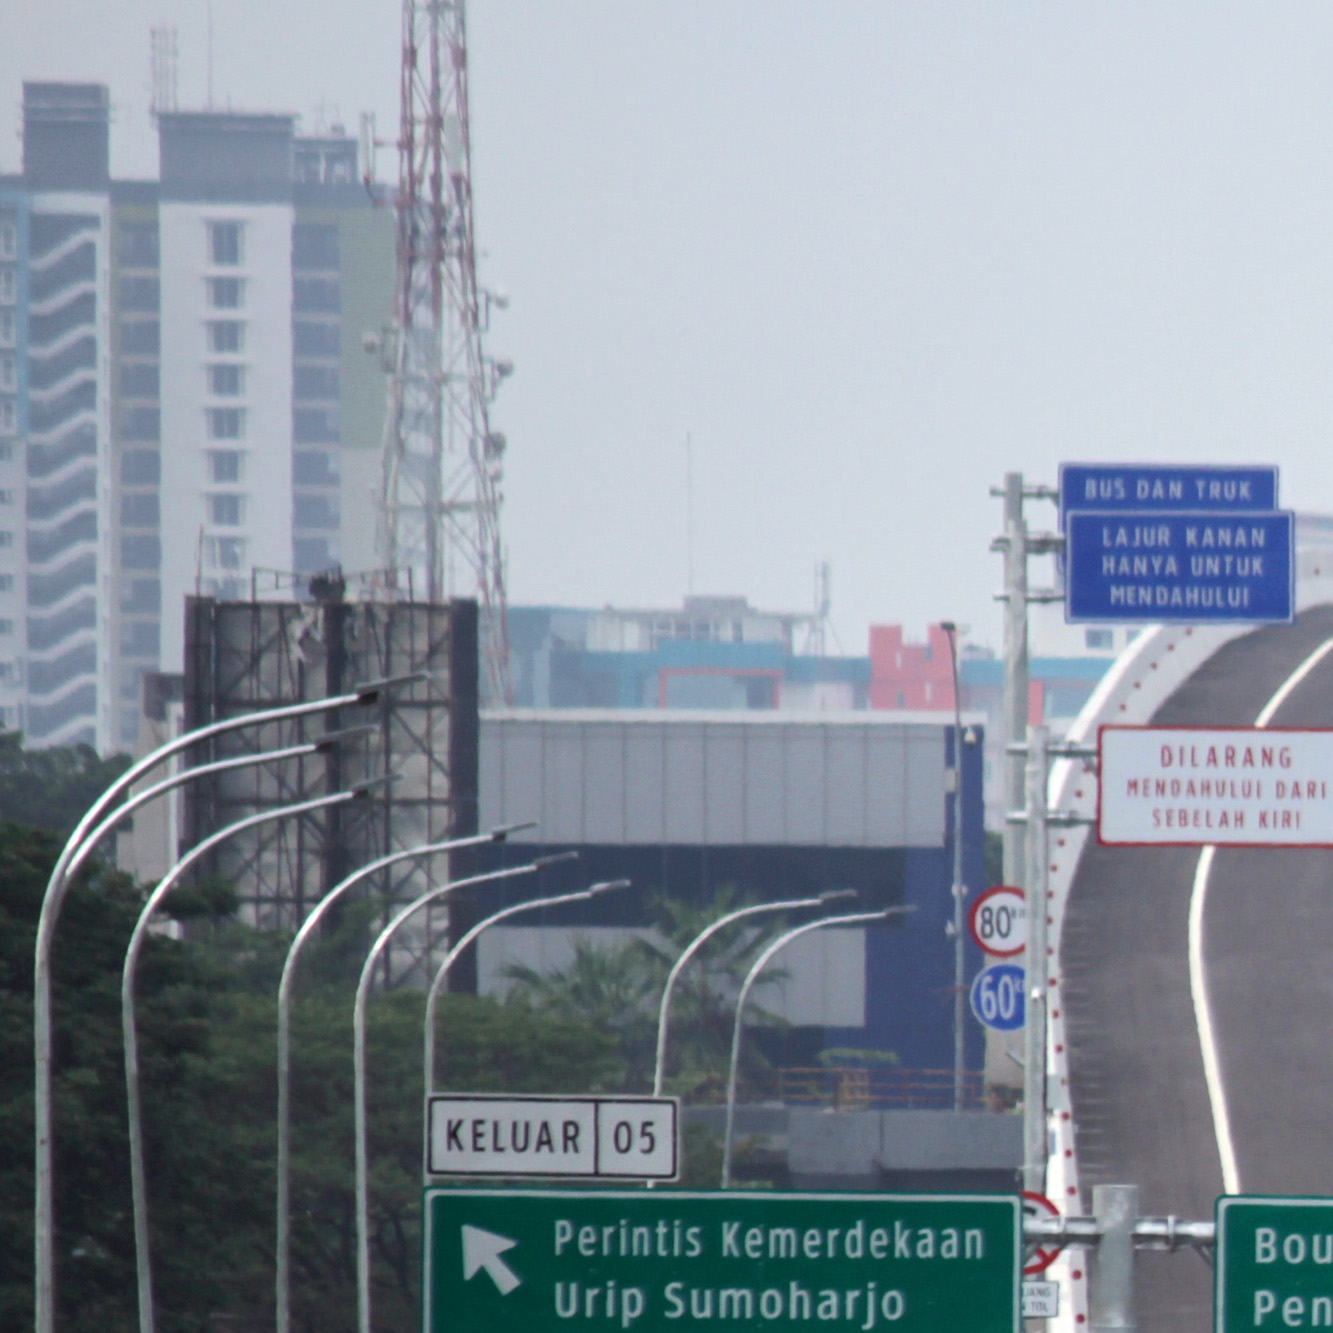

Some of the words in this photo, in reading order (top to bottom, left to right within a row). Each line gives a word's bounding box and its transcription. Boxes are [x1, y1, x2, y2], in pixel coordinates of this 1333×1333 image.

[1084, 478, 1125, 500] BUS
[1137, 479, 1182, 499] DAN
[1196, 480, 1252, 500] TRUK
[1103, 526, 1171, 547] LAJUR
[1186, 527, 1265, 547] KANAN
[1102, 555, 1178, 576] HANYA
[1191, 556, 1264, 576] UNTUK
[1110, 585, 1249, 608] MENDAHULUI
[1161, 745, 1292, 769] DILARANG
[1126, 778, 1262, 800] MENDAHULUI
[1276, 779, 1327, 800] DARI
[1152, 809, 1245, 829] SEBELAH
[1259, 810, 1302, 830] KIRI
[981, 906, 1010, 939] 80
[980, 975, 1015, 1020] 60
[446, 1118, 581, 1154] KELUAR
[613, 1120, 657, 1154] 05
[554, 1219, 701, 1259] Perintis
[722, 1220, 984, 1260] Kemerdekaan
[554, 1281, 645, 1329] Urip
[664, 1281, 905, 1331] Sumoharjo
